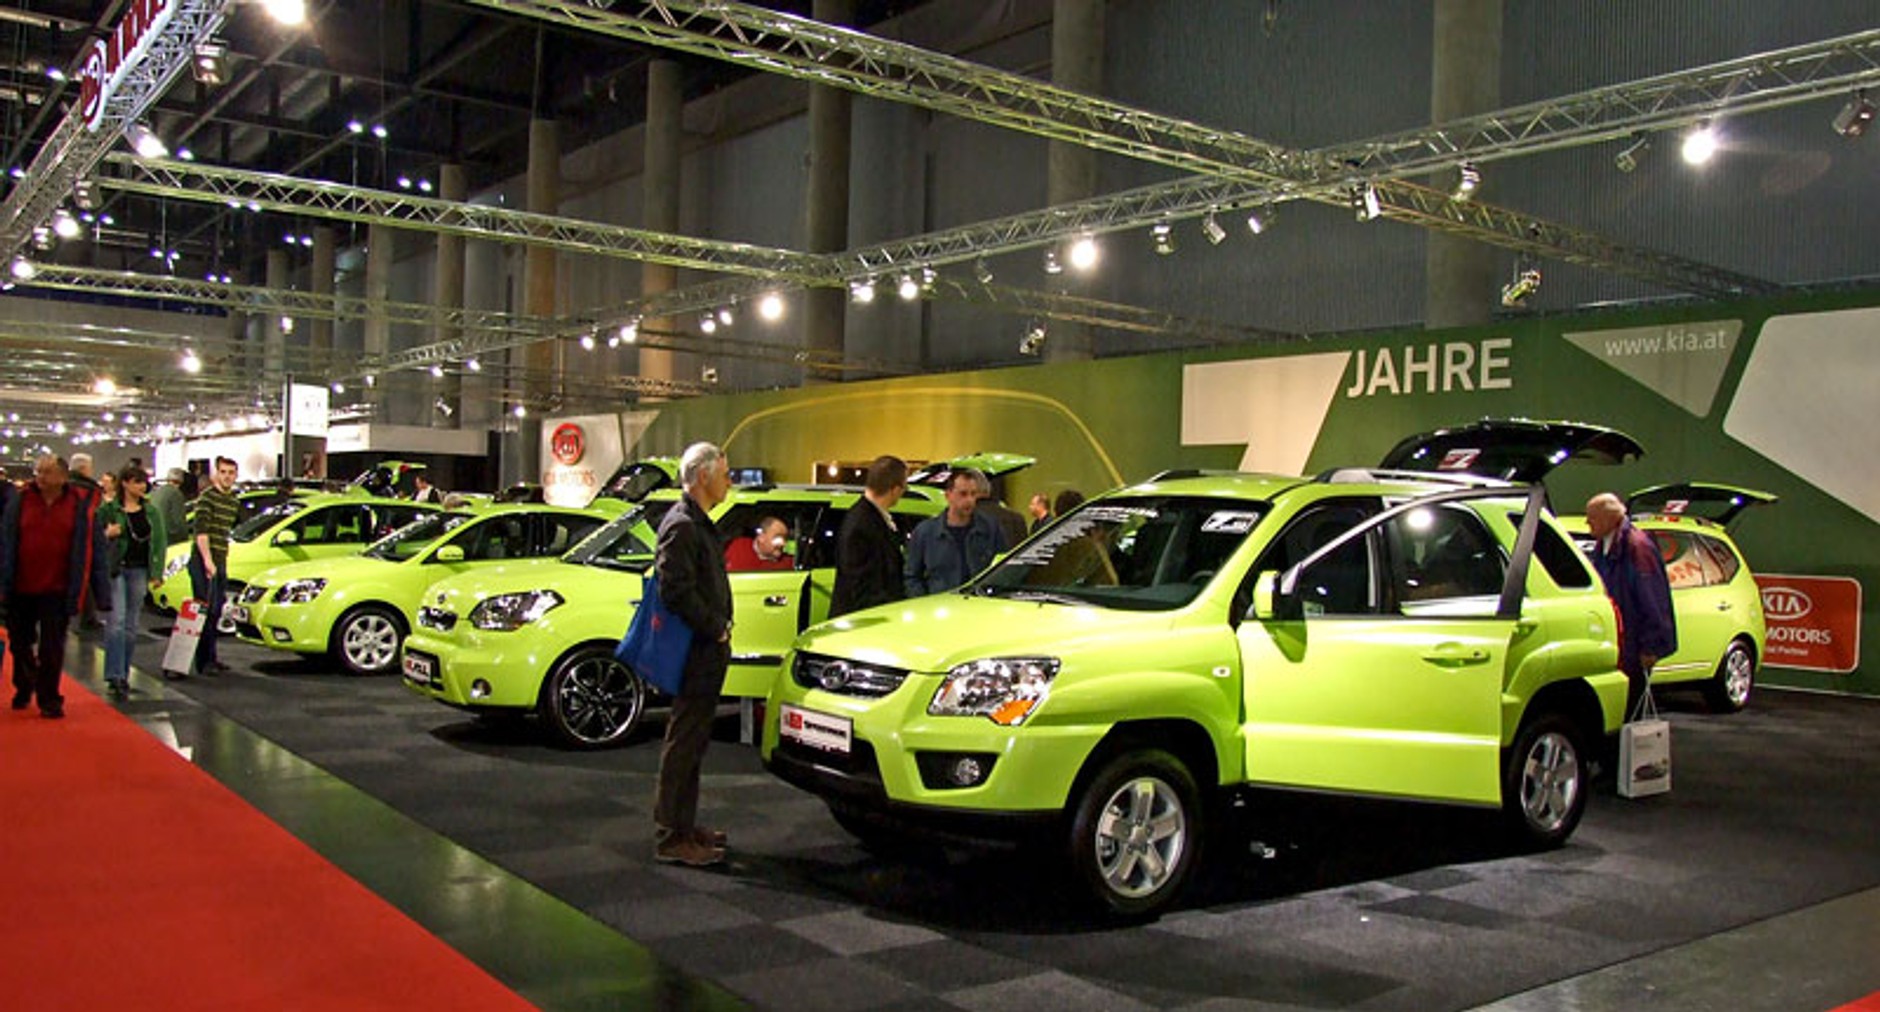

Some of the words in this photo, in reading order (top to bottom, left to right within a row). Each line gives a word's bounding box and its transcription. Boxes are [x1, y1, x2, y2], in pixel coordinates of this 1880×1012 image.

[1604, 329, 1727, 356] www.kia.at
[1346, 338, 1512, 398] JAHRE
[1763, 594, 1800, 612] KIA
